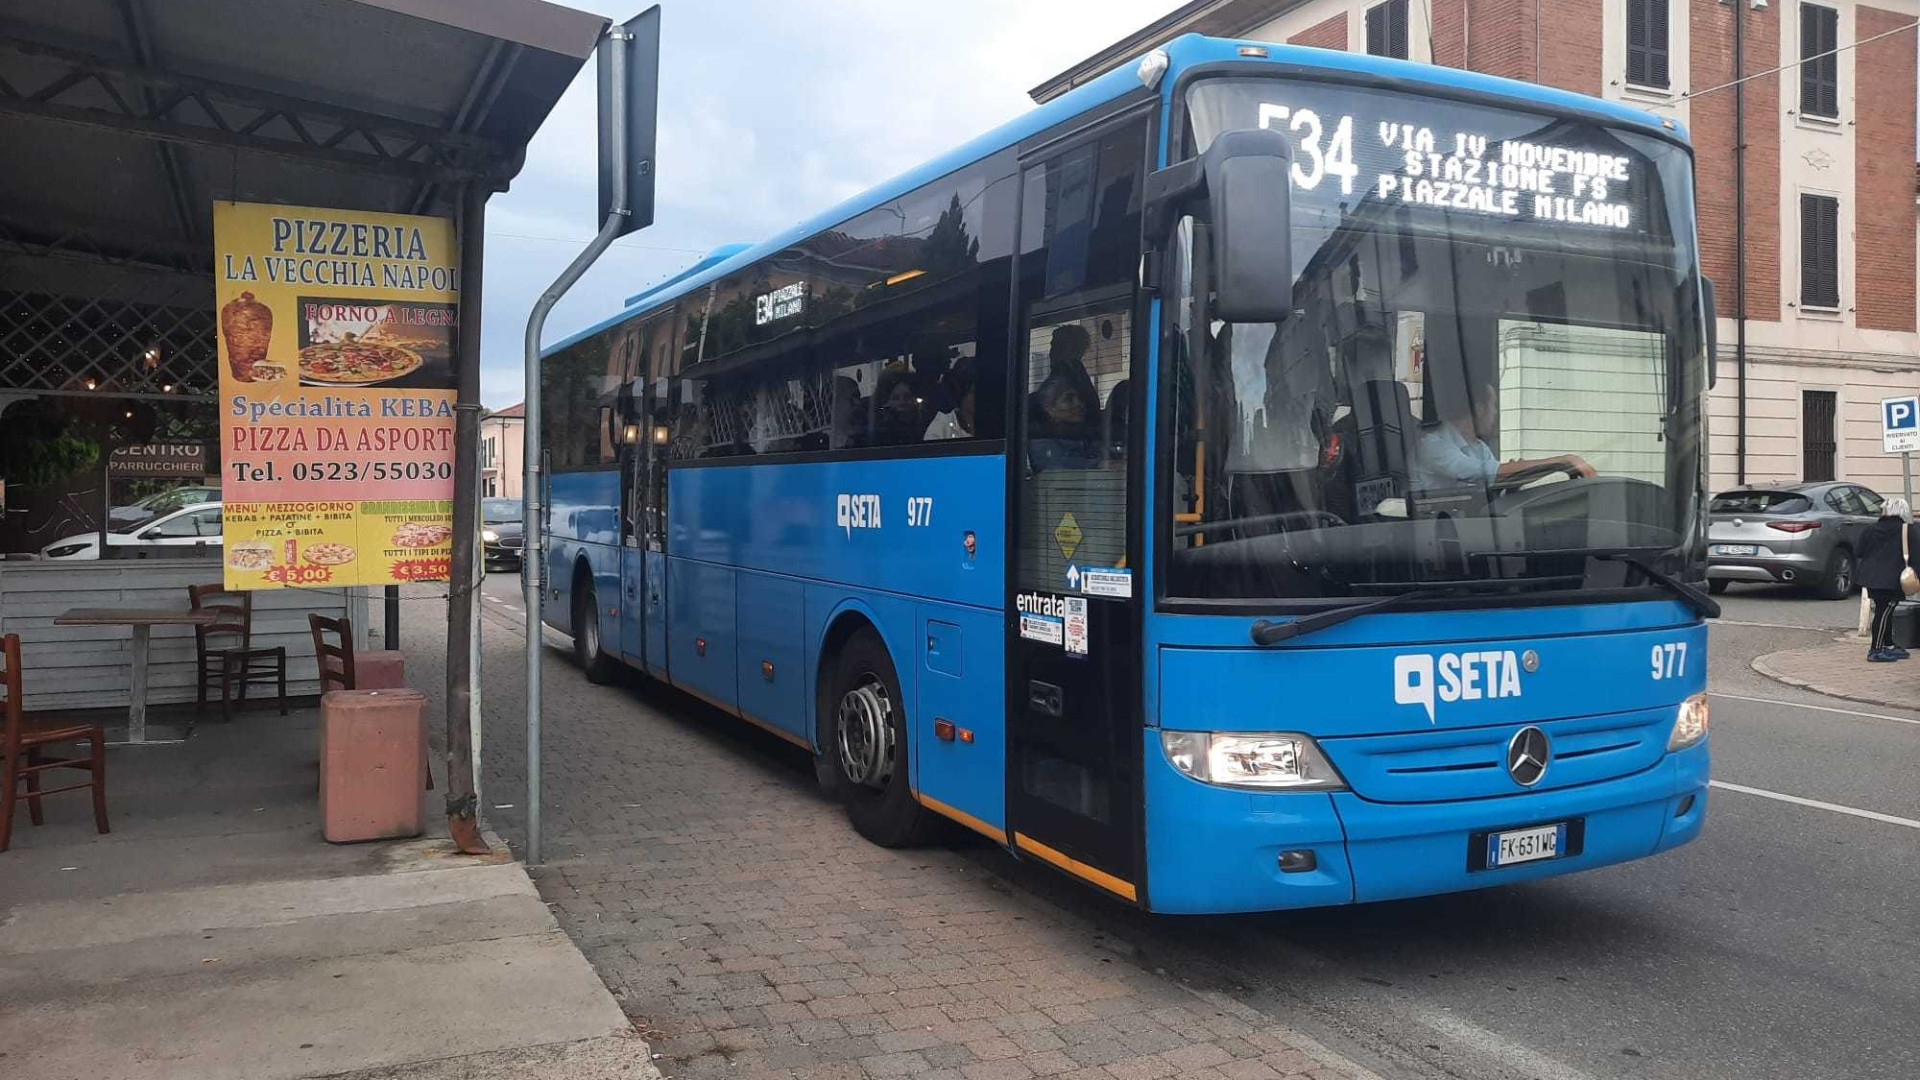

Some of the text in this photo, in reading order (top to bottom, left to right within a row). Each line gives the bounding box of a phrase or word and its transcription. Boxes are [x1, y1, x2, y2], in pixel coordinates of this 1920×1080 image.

[1379, 121, 1630, 181] VIA IV NOVEMBRE
[1404, 149, 1607, 200] STAZIONE FS
[1379, 174, 1630, 228] PIAZZALE MILANO
[272, 217, 427, 261] PIZZERIA
[225, 254, 257, 281] LA
[264, 256, 376, 287] VECCHIA
[305, 303, 378, 323] FORNO
[385, 306, 398, 325] A
[756, 293, 773, 325] E34
[1891, 403, 1909, 427] P
[232, 426, 457, 451] PIZZA DA ASPORT
[109, 461, 203, 471] PARRUCCHIERI
[232, 461, 282, 481] Tel.
[224, 502, 354, 513] MENU' MEZZOGIORNO
[225, 514, 257, 522] KEBAB
[324, 512, 352, 520] BIBITA
[907, 497, 933, 527] 977
[256, 529, 282, 537] PIZZA
[295, 528, 324, 536] BIBITA
[383, 549, 407, 557] TUTTI
[1016, 592, 1065, 617] entrata
[1438, 641, 1687, 702] SETA 977
